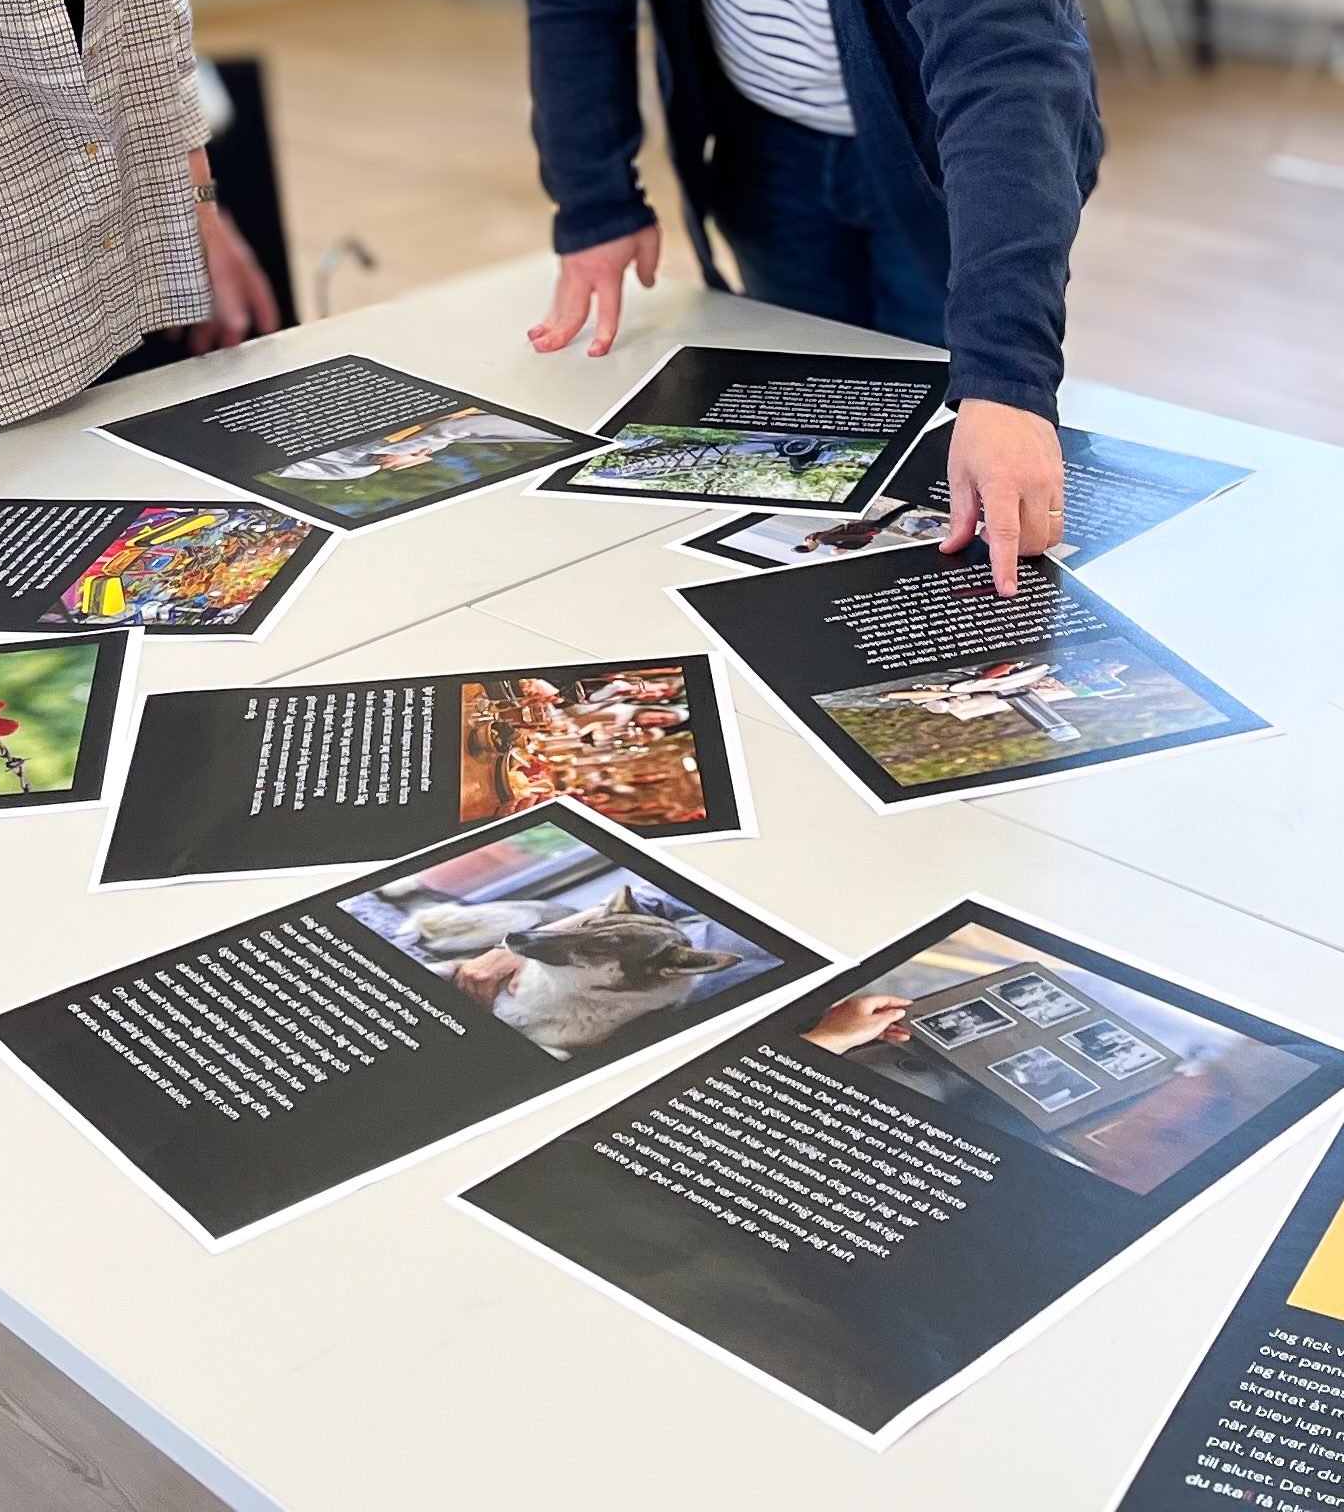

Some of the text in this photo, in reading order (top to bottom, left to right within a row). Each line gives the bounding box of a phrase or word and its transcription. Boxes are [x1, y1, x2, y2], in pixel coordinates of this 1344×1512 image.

[740, 1056, 993, 1181] med mamma. Det gick bara inte. Ibland kunde
[758, 1045, 1000, 1164] De sista femton åren hade jag ingen kontakt
[723, 1067, 961, 1185] släkt och vänner fråga mig om vi inte borde
[1260, 1346, 1297, 1362] över
[1269, 1328, 1299, 1345] Jag
[1302, 1337, 1332, 1353] fick
[1247, 1362, 1274, 1379] jag
[1240, 1382, 1306, 1407] skrattat
[1309, 1400, 1328, 1413] åt
[1218, 1418, 1247, 1432] när
[1247, 1425, 1276, 1443] jag
[1280, 1436, 1306, 1450] var
[1229, 1400, 1252, 1412] du
[1255, 1406, 1292, 1424] blev
[1295, 1417, 1331, 1436] lugn
[1206, 1437, 1244, 1456] palt,
[1250, 1447, 1284, 1466] leka
[1290, 1460, 1314, 1474] får
[1317, 1470, 1341, 1483] du
[1186, 1474, 1210, 1488] du
[1256, 1494, 1273, 1508] få
[1198, 1455, 1219, 1469] till
[1221, 1463, 1273, 1486] slutet.
[1280, 1479, 1311, 1497] Det
[1317, 1492, 1344, 1506] var
